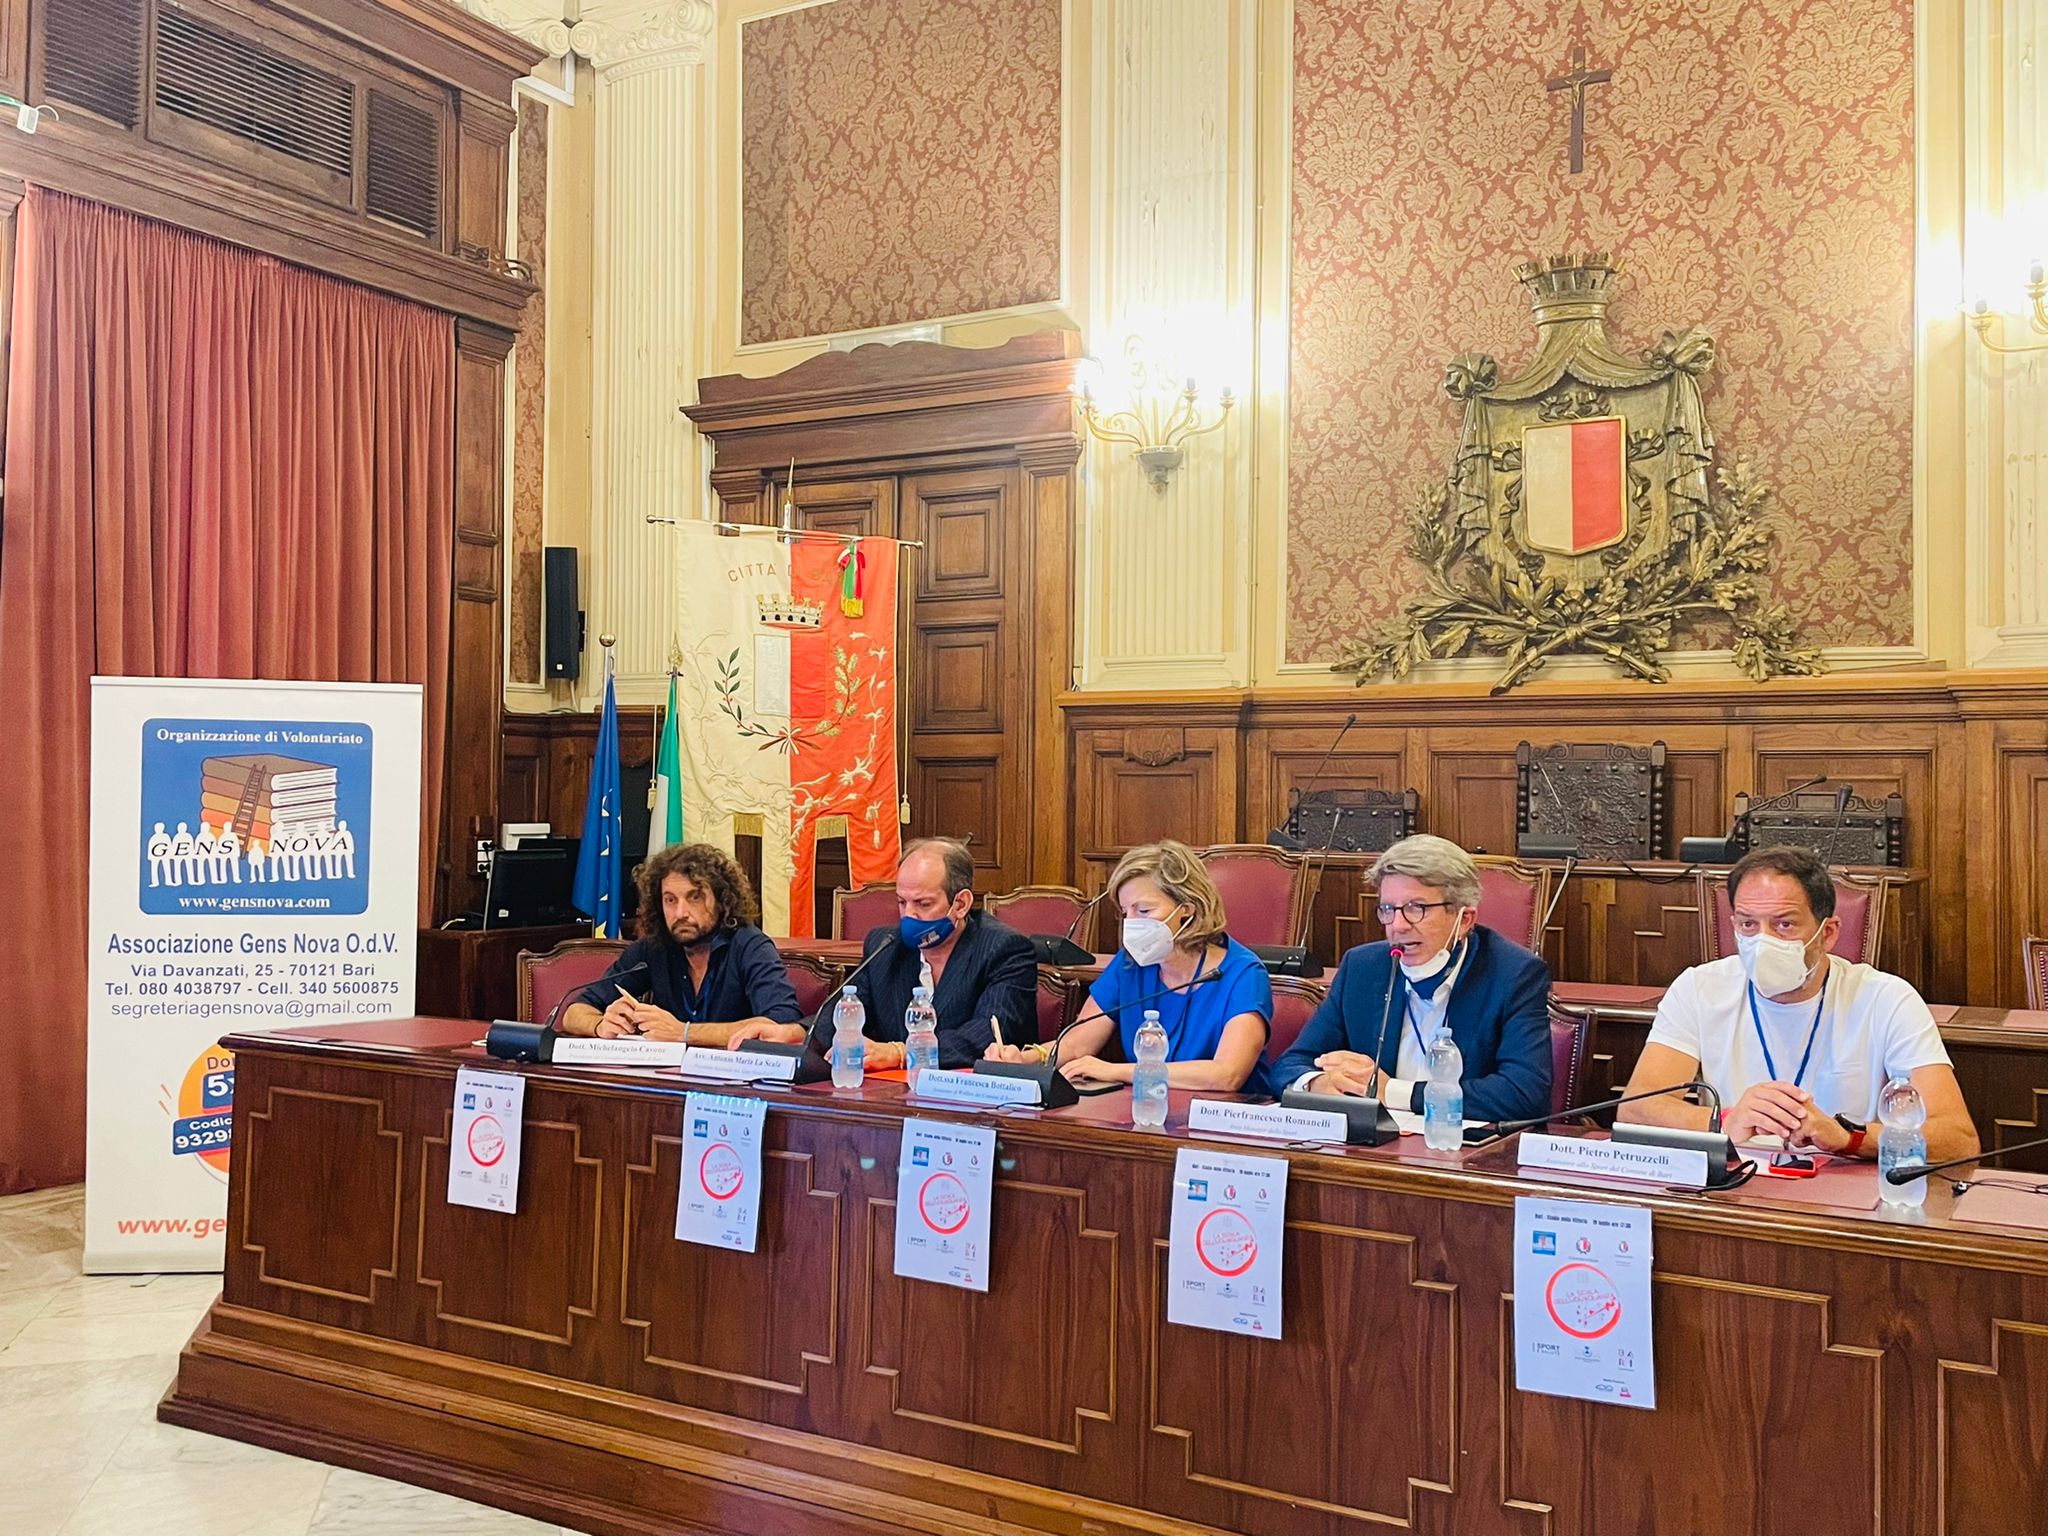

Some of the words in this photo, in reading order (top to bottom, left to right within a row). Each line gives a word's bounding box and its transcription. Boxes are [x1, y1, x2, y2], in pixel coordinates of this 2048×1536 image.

[157, 729, 261, 743] Organizzazione
[265, 730, 278, 742] di
[282, 731, 363, 745] Volontariato
[151, 840, 235, 856] GENS
[271, 837, 348, 853] NOVA
[178, 896, 331, 911] www.gensnova.com
[107, 933, 233, 954] Associazione
[240, 933, 287, 954] Gens
[294, 933, 340, 953] Nova
[346, 933, 398, 953] O.d.V.
[131, 964, 157, 977] Via
[163, 964, 249, 979] Davanzati,
[255, 964, 273, 976] 25
[289, 964, 336, 976] 70121
[343, 964, 375, 976] Bari
[105, 983, 133, 995] Tel.
[138, 983, 168, 995] 080
[174, 982, 241, 995] 4038797
[258, 982, 293, 995] Cell.
[299, 982, 327, 995] 340
[333, 982, 399, 994] 5600875
[111, 1000, 392, 1018] segreteriagensnova@gmail.com
[207, 1057, 235, 1070] Do
[189, 1118, 232, 1130] Codic
[1224, 1109, 1283, 1123] Pierfrancesco
[1285, 1115, 1331, 1128] Romanelli
[1550, 1143, 1575, 1155] Dott.
[1579, 1146, 1610, 1158] Pietro
[1613, 1150, 1669, 1165] Petruzzelli
[117, 1217, 226, 1239] www.ge
